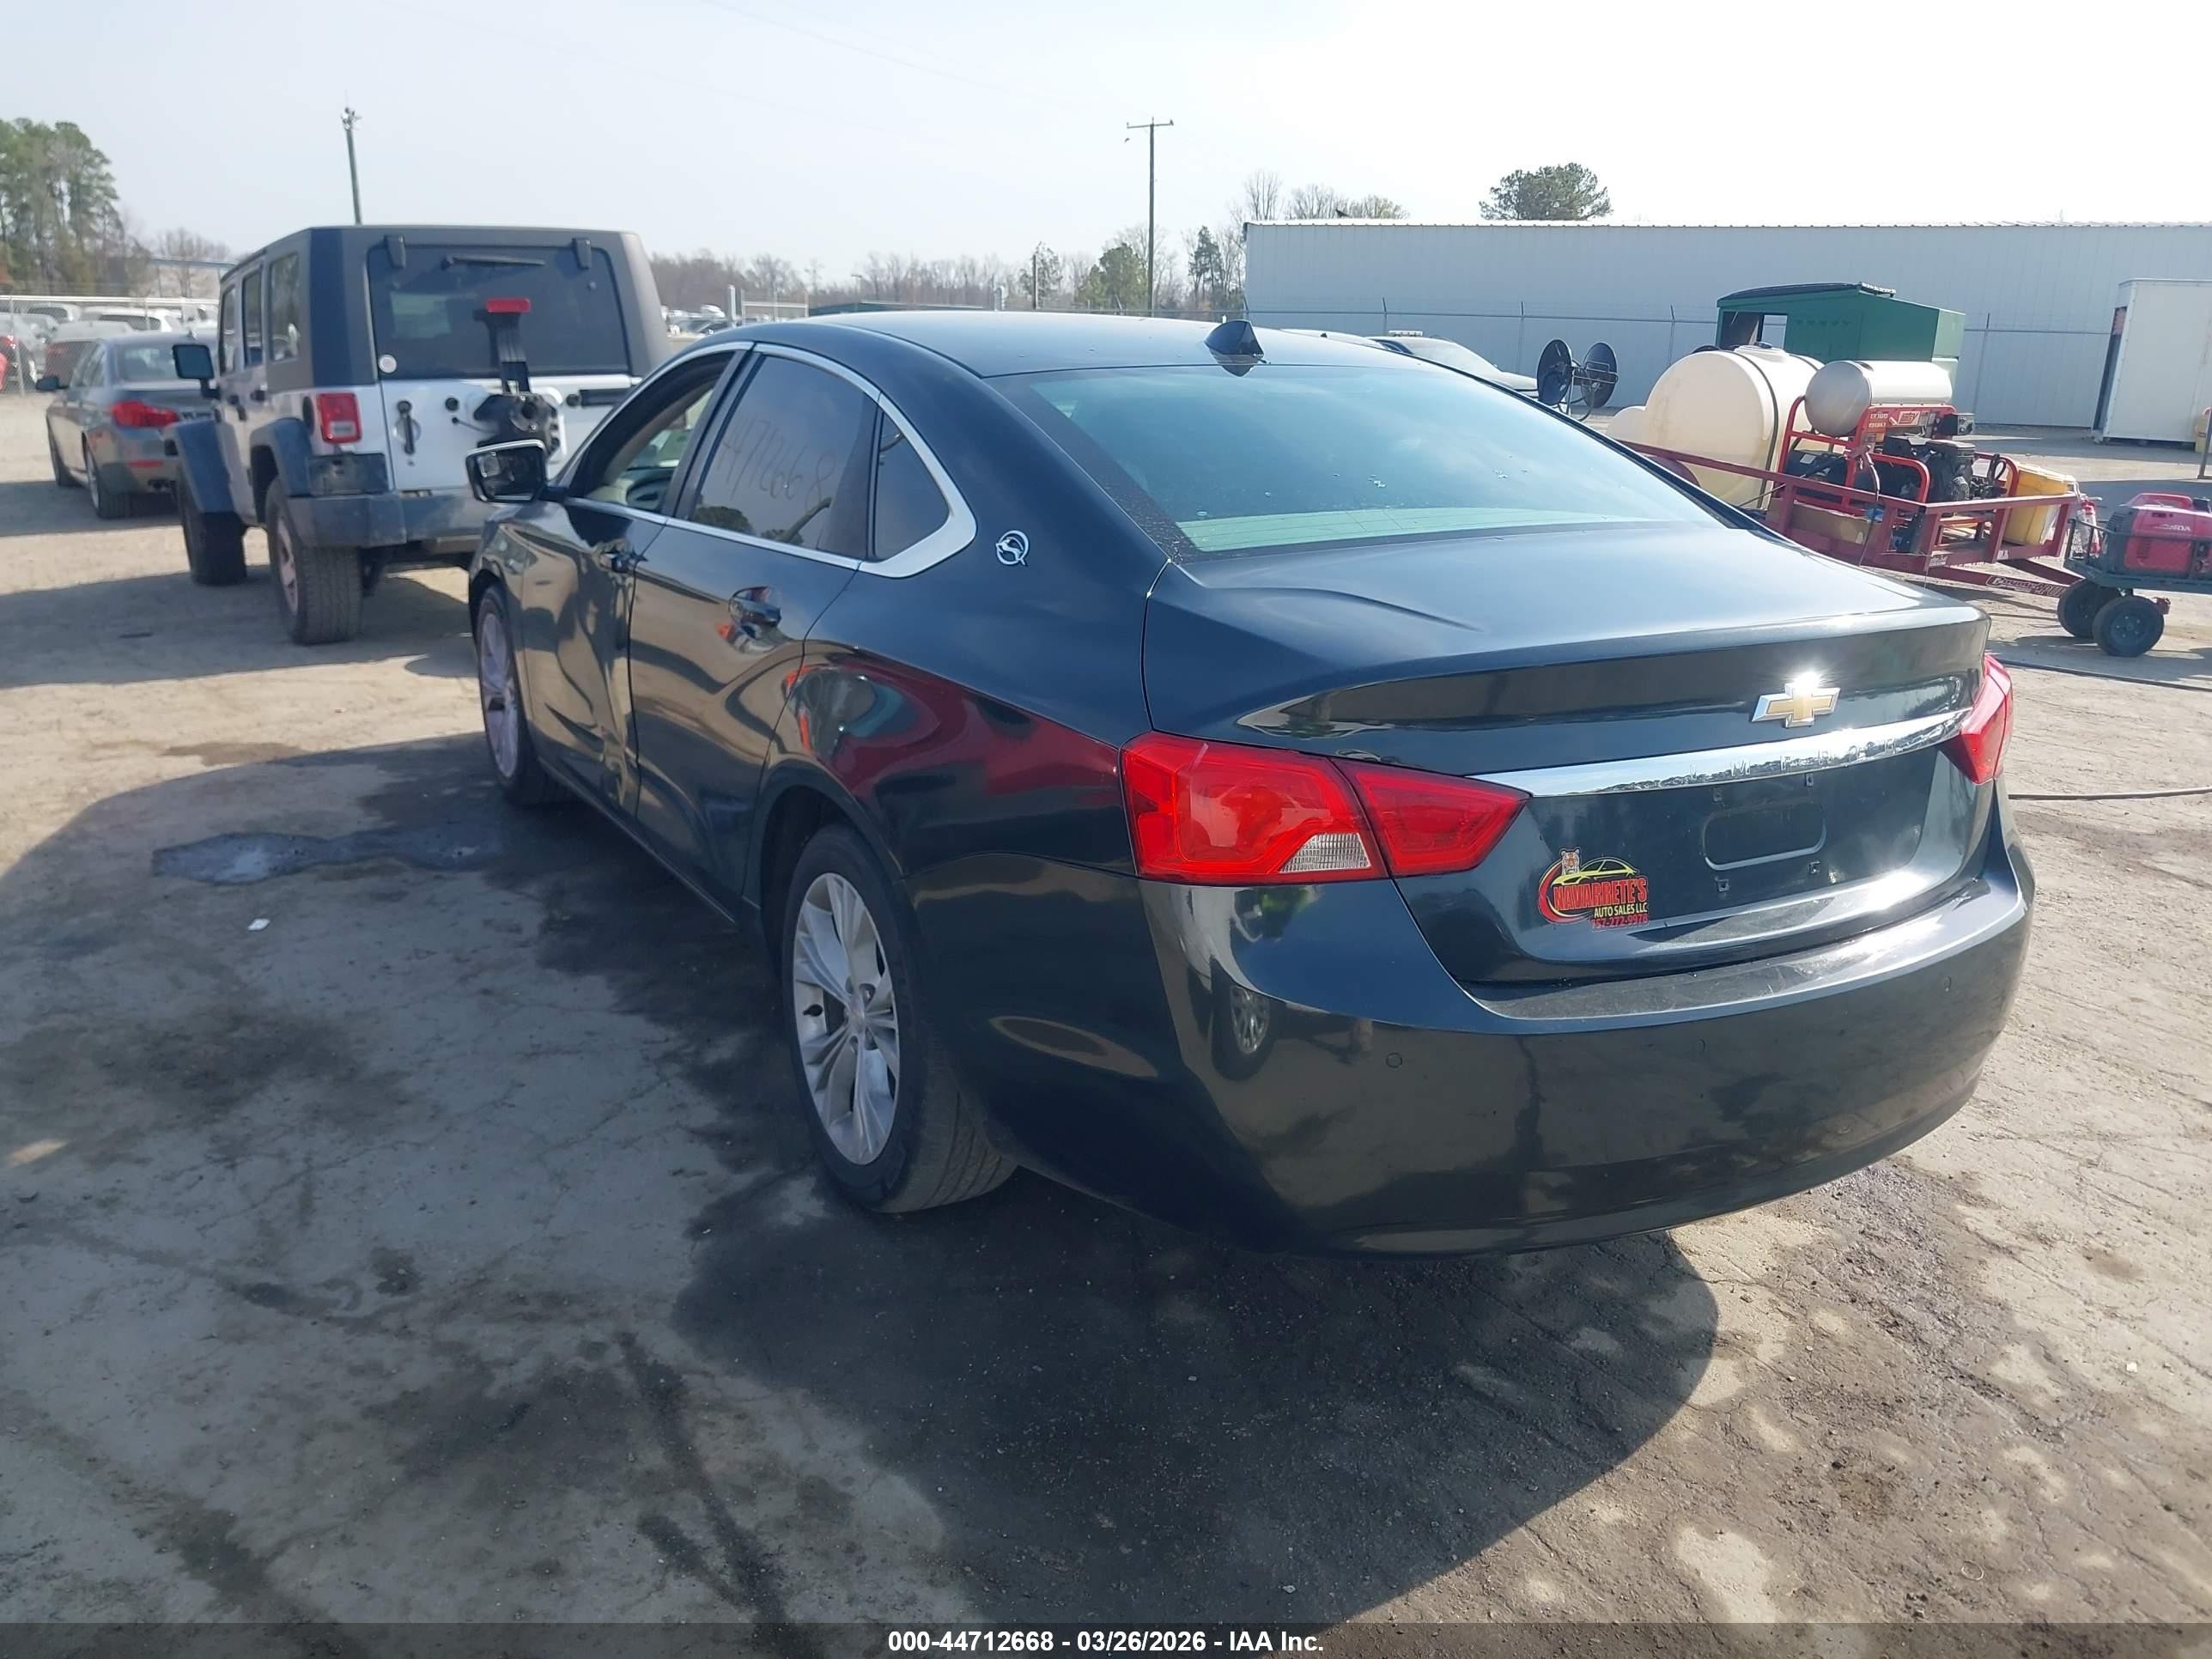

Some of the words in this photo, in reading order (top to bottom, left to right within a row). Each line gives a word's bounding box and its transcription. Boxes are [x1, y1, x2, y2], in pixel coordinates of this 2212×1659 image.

[1553, 877, 1648, 911] NAVARRETE'S
[1594, 906, 1613, 918] AUTO
[1613, 904, 1635, 915] SALES
[1635, 902, 1648, 914] LLC
